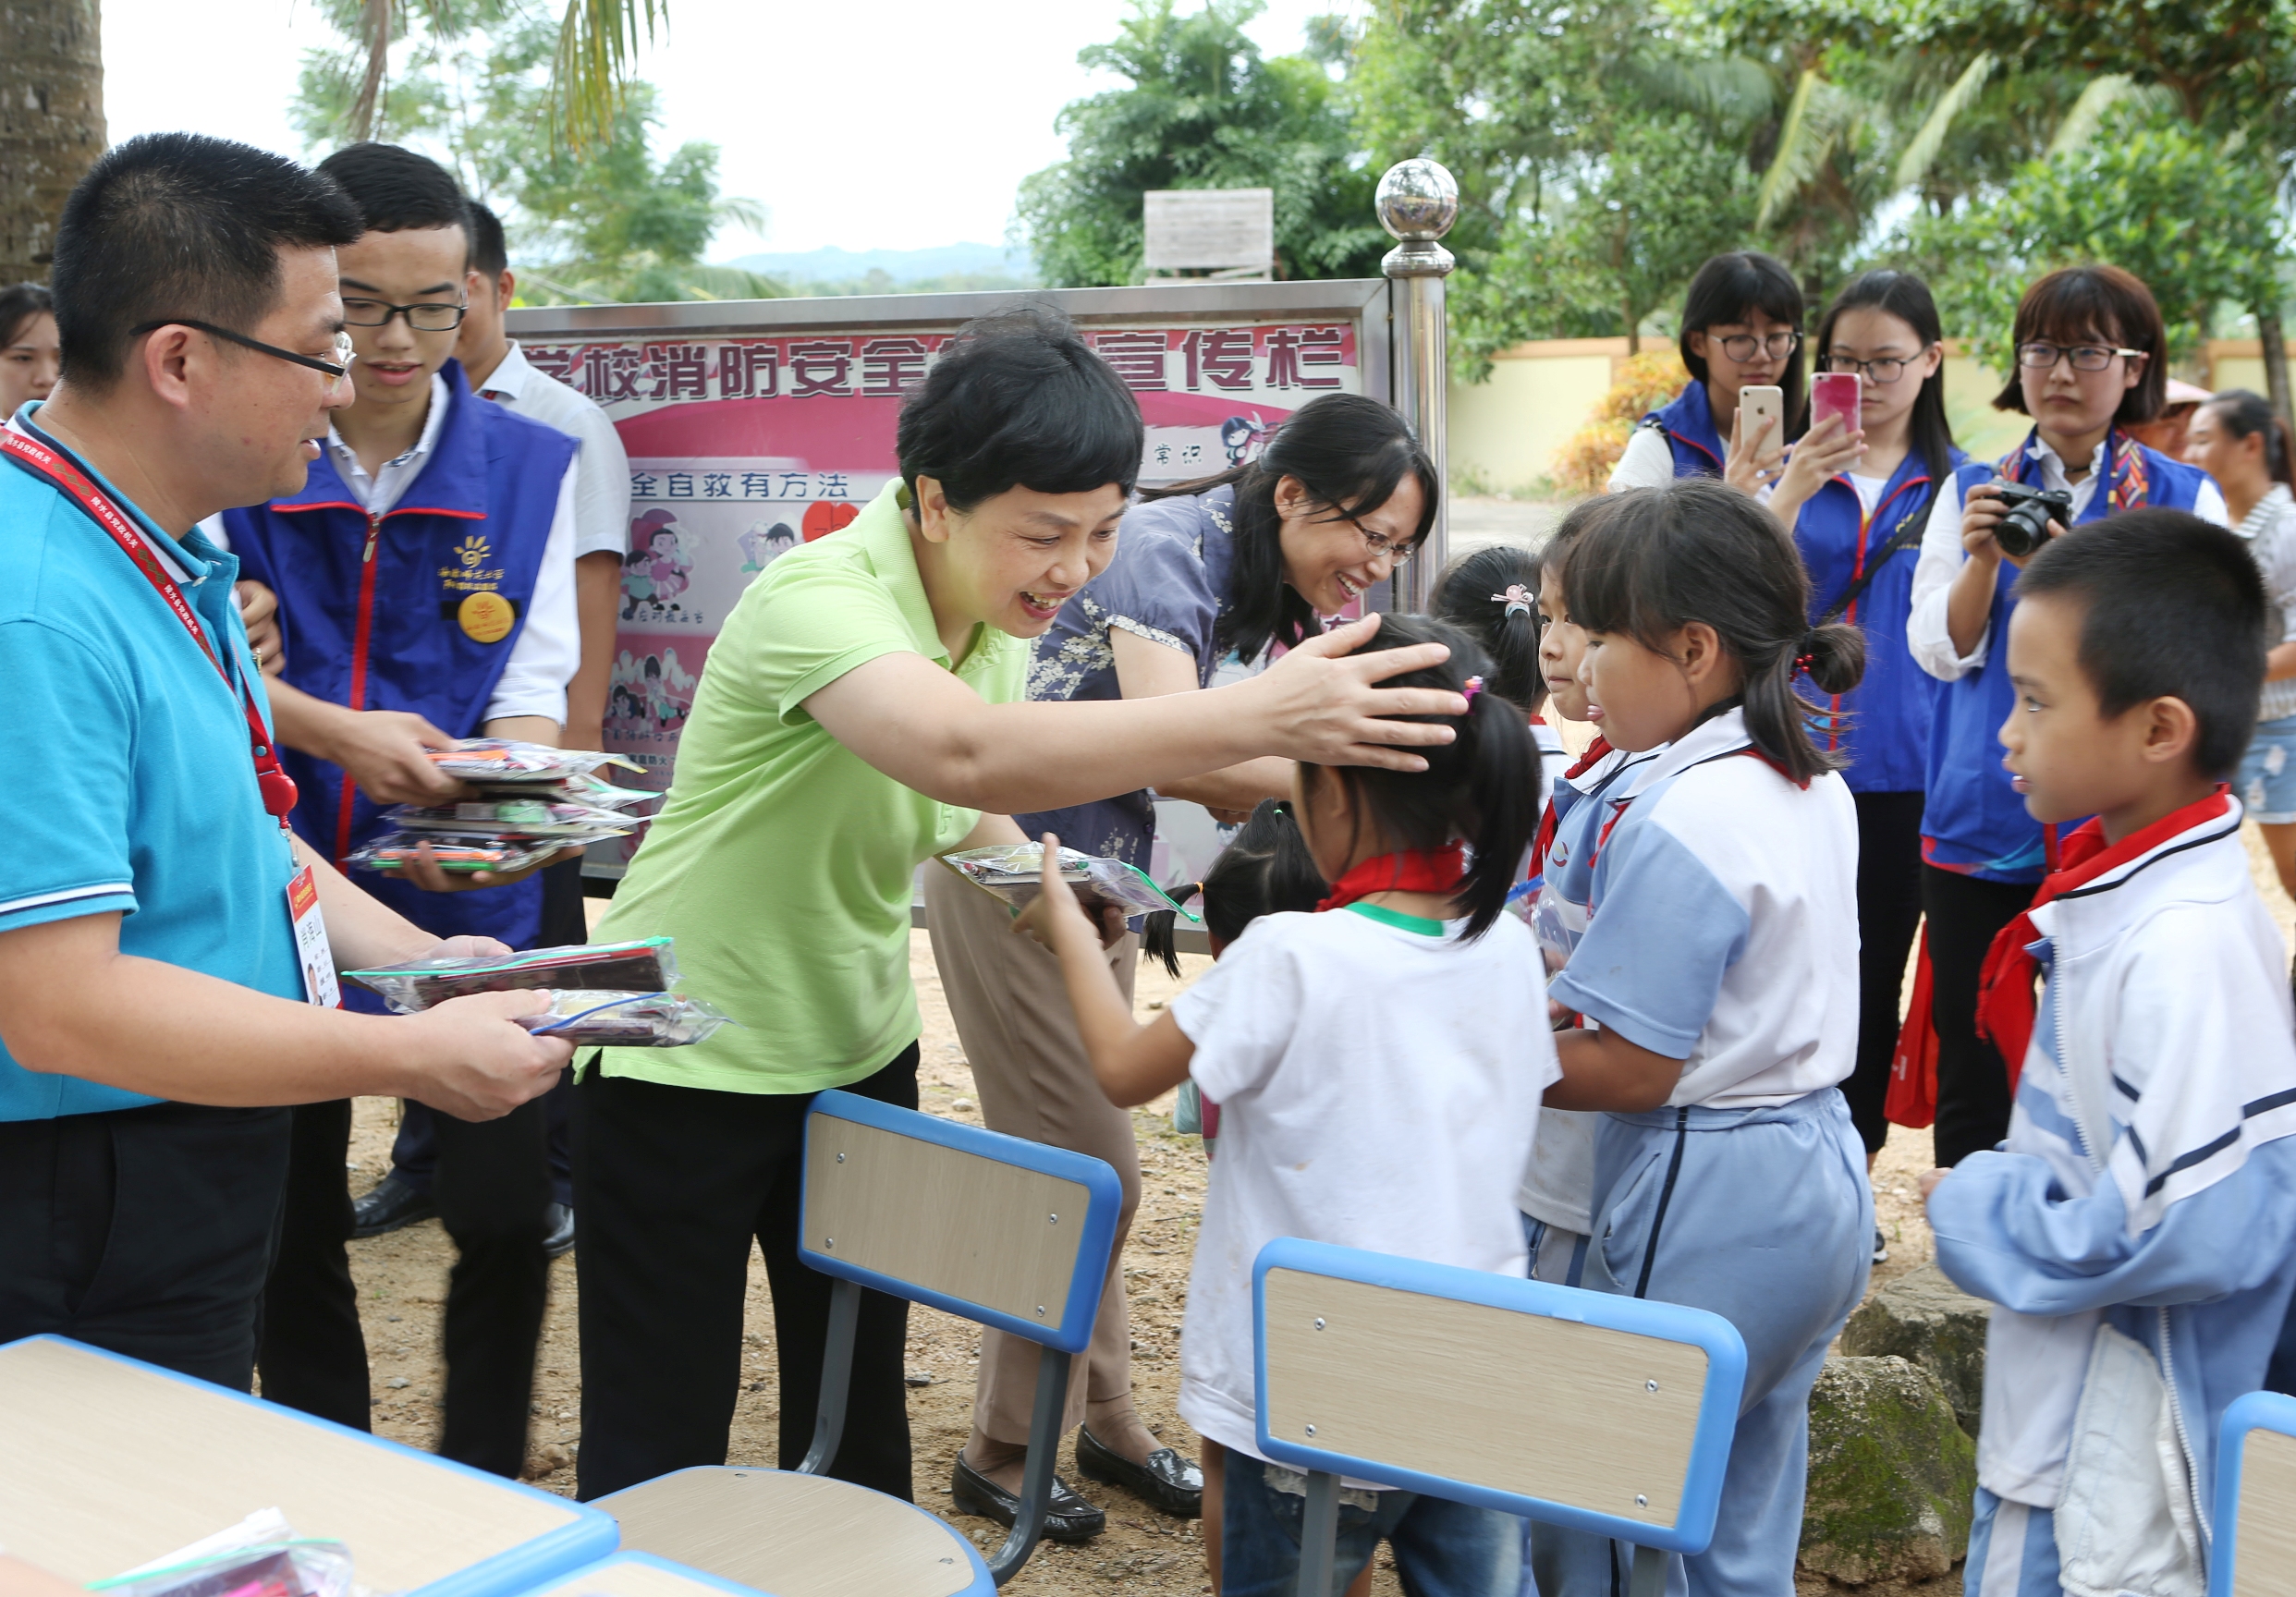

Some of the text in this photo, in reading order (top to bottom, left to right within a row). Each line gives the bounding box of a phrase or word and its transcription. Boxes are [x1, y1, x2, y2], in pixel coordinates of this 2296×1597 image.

[1141, 444, 1202, 467] 常识
[91, 496, 140, 548] 陵水县党政机关
